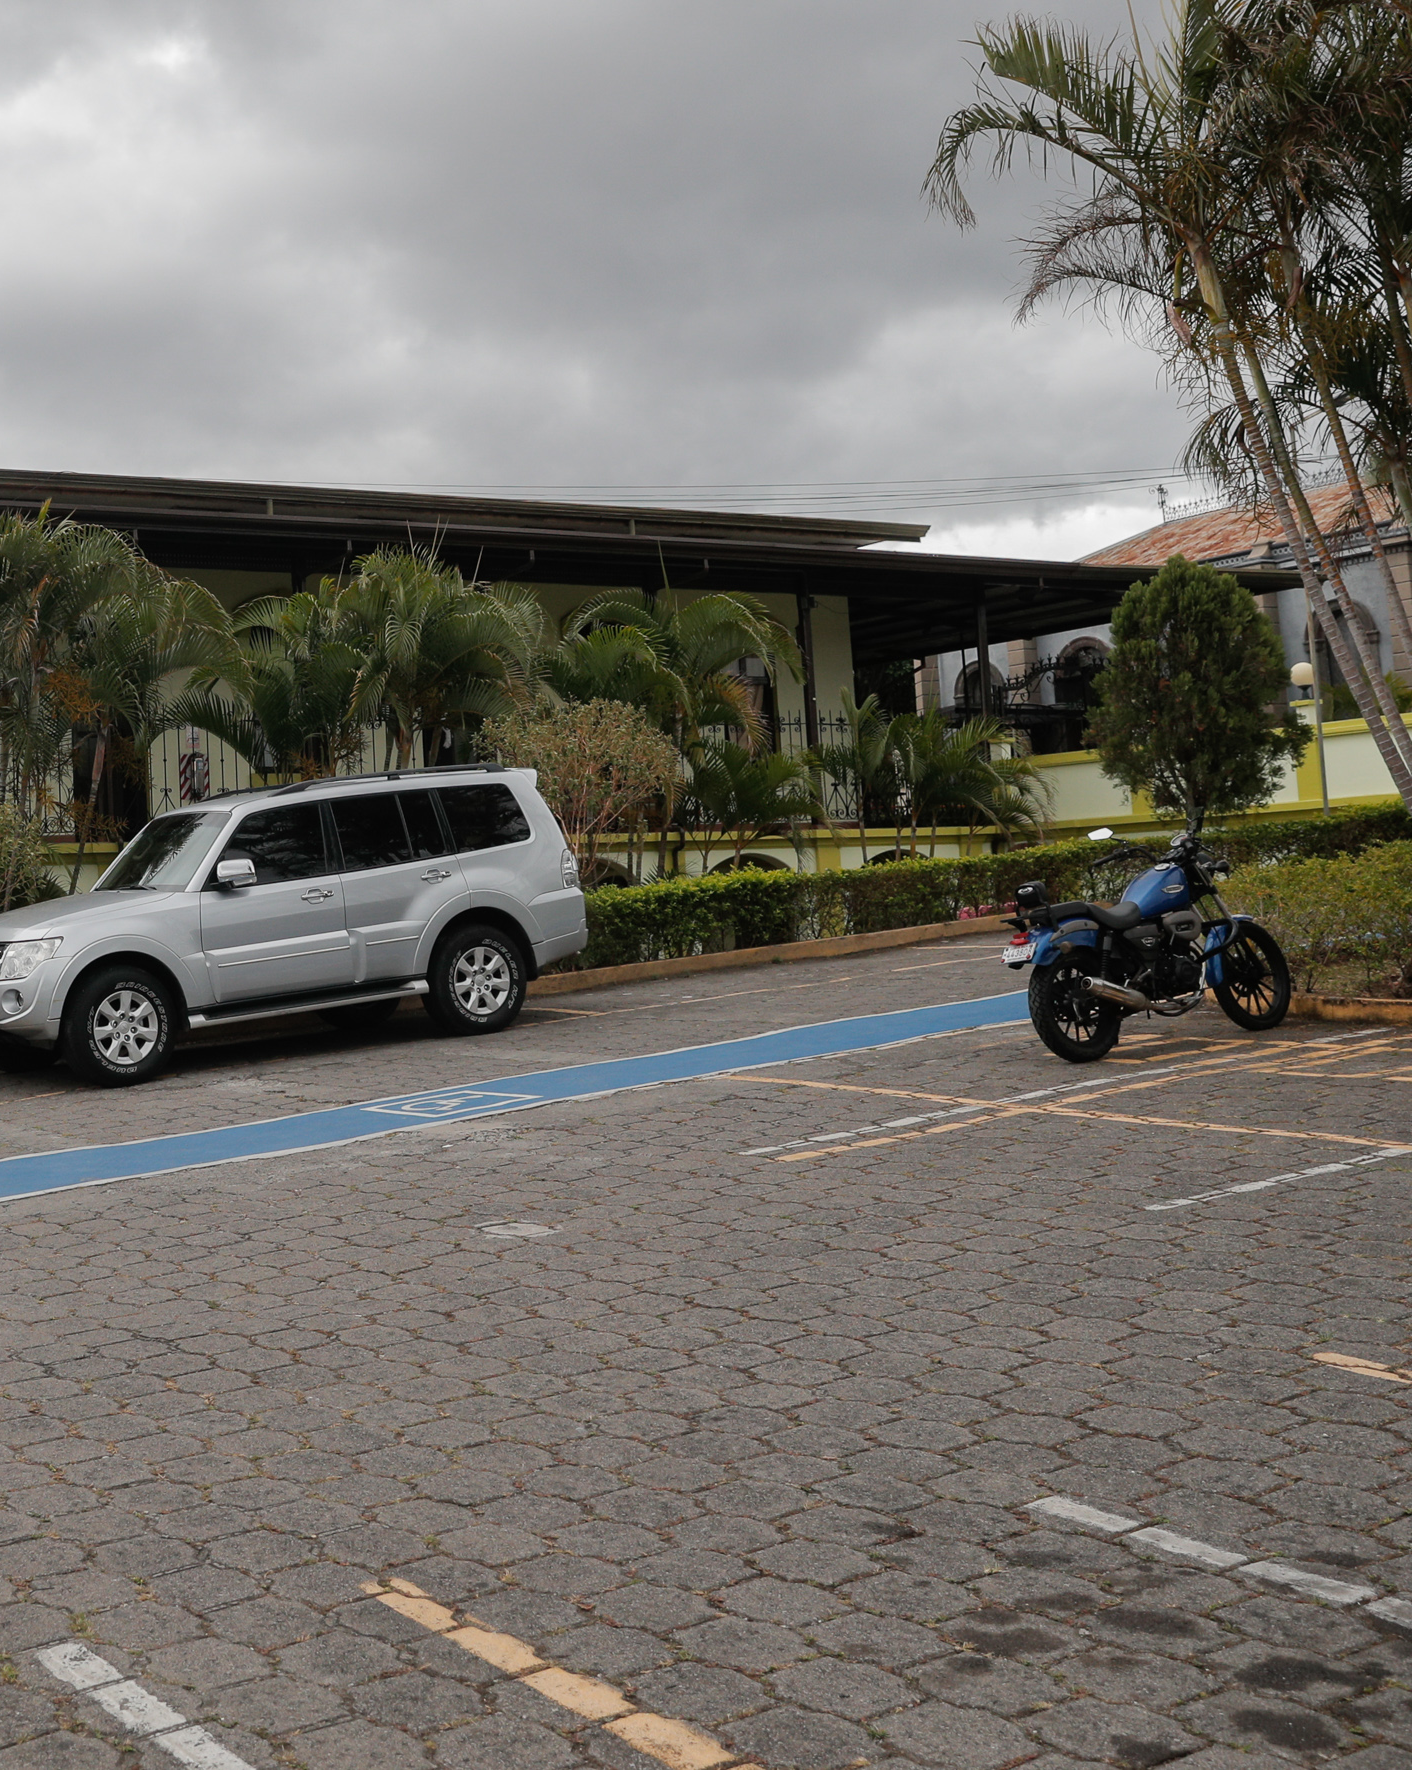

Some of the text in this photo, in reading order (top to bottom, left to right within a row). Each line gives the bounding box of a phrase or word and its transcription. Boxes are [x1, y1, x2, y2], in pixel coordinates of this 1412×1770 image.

[482, 938, 519, 979] DUELER
[115, 981, 168, 1053] BRIDGESTONE
[88, 1039, 138, 1074] DUELER
